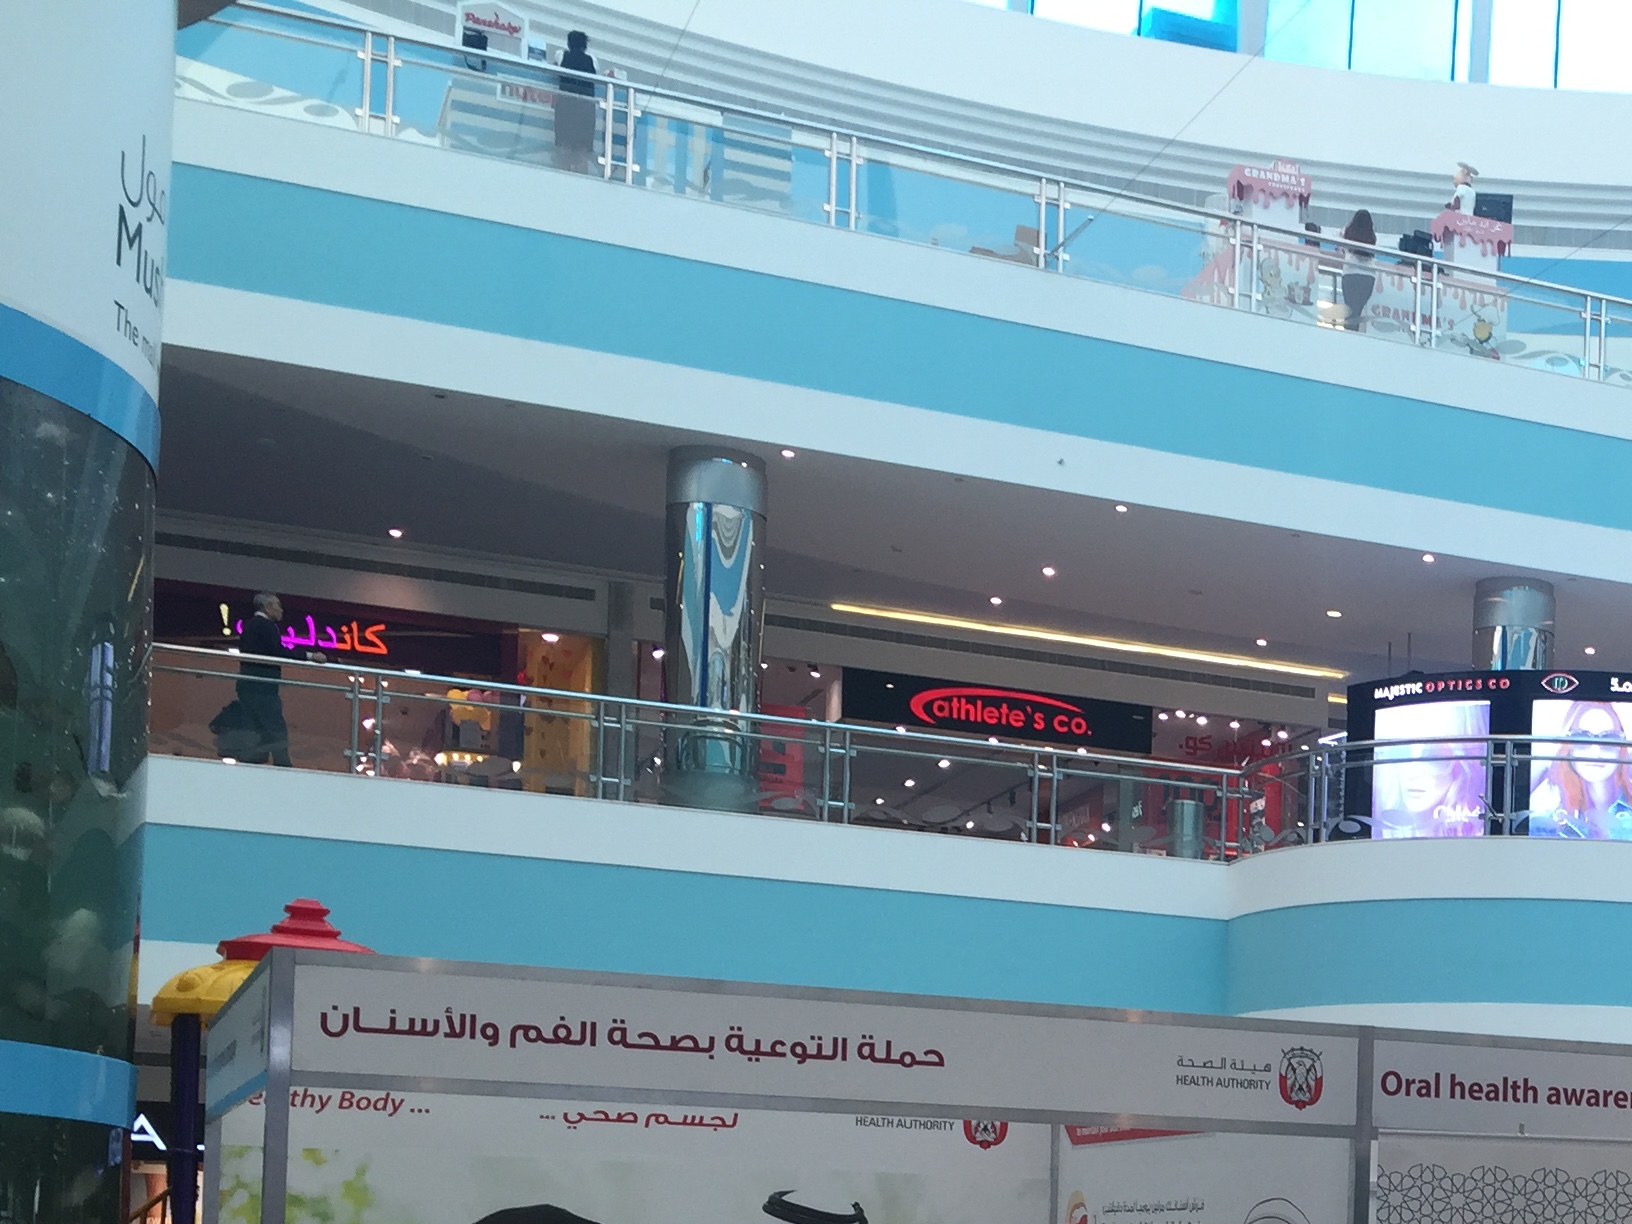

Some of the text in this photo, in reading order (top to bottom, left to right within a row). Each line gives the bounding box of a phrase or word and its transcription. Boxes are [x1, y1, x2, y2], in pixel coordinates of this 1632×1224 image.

[113, 299, 139, 346] The
[1374, 678, 1510, 700] MAJESTIC OPTICS CO
[932, 697, 1092, 736] athlete's co.
[509, 1015, 597, 1048] الفم
[607, 1018, 716, 1060] بصحة
[724, 1025, 848, 1065] التوعية
[856, 1033, 946, 1068] حملة
[1176, 1055, 1272, 1074] هيئة الصحة
[1176, 1075, 1271, 1090] HEALTH AUTHORITY
[1380, 1070, 1441, 1099] Oral
[1449, 1074, 1539, 1104] health
[337, 1091, 405, 1117] Body
[562, 1109, 638, 1130] صحي
[644, 1112, 739, 1132] لجسم
[855, 1115, 955, 1132] HEALTH AUTHORITY
